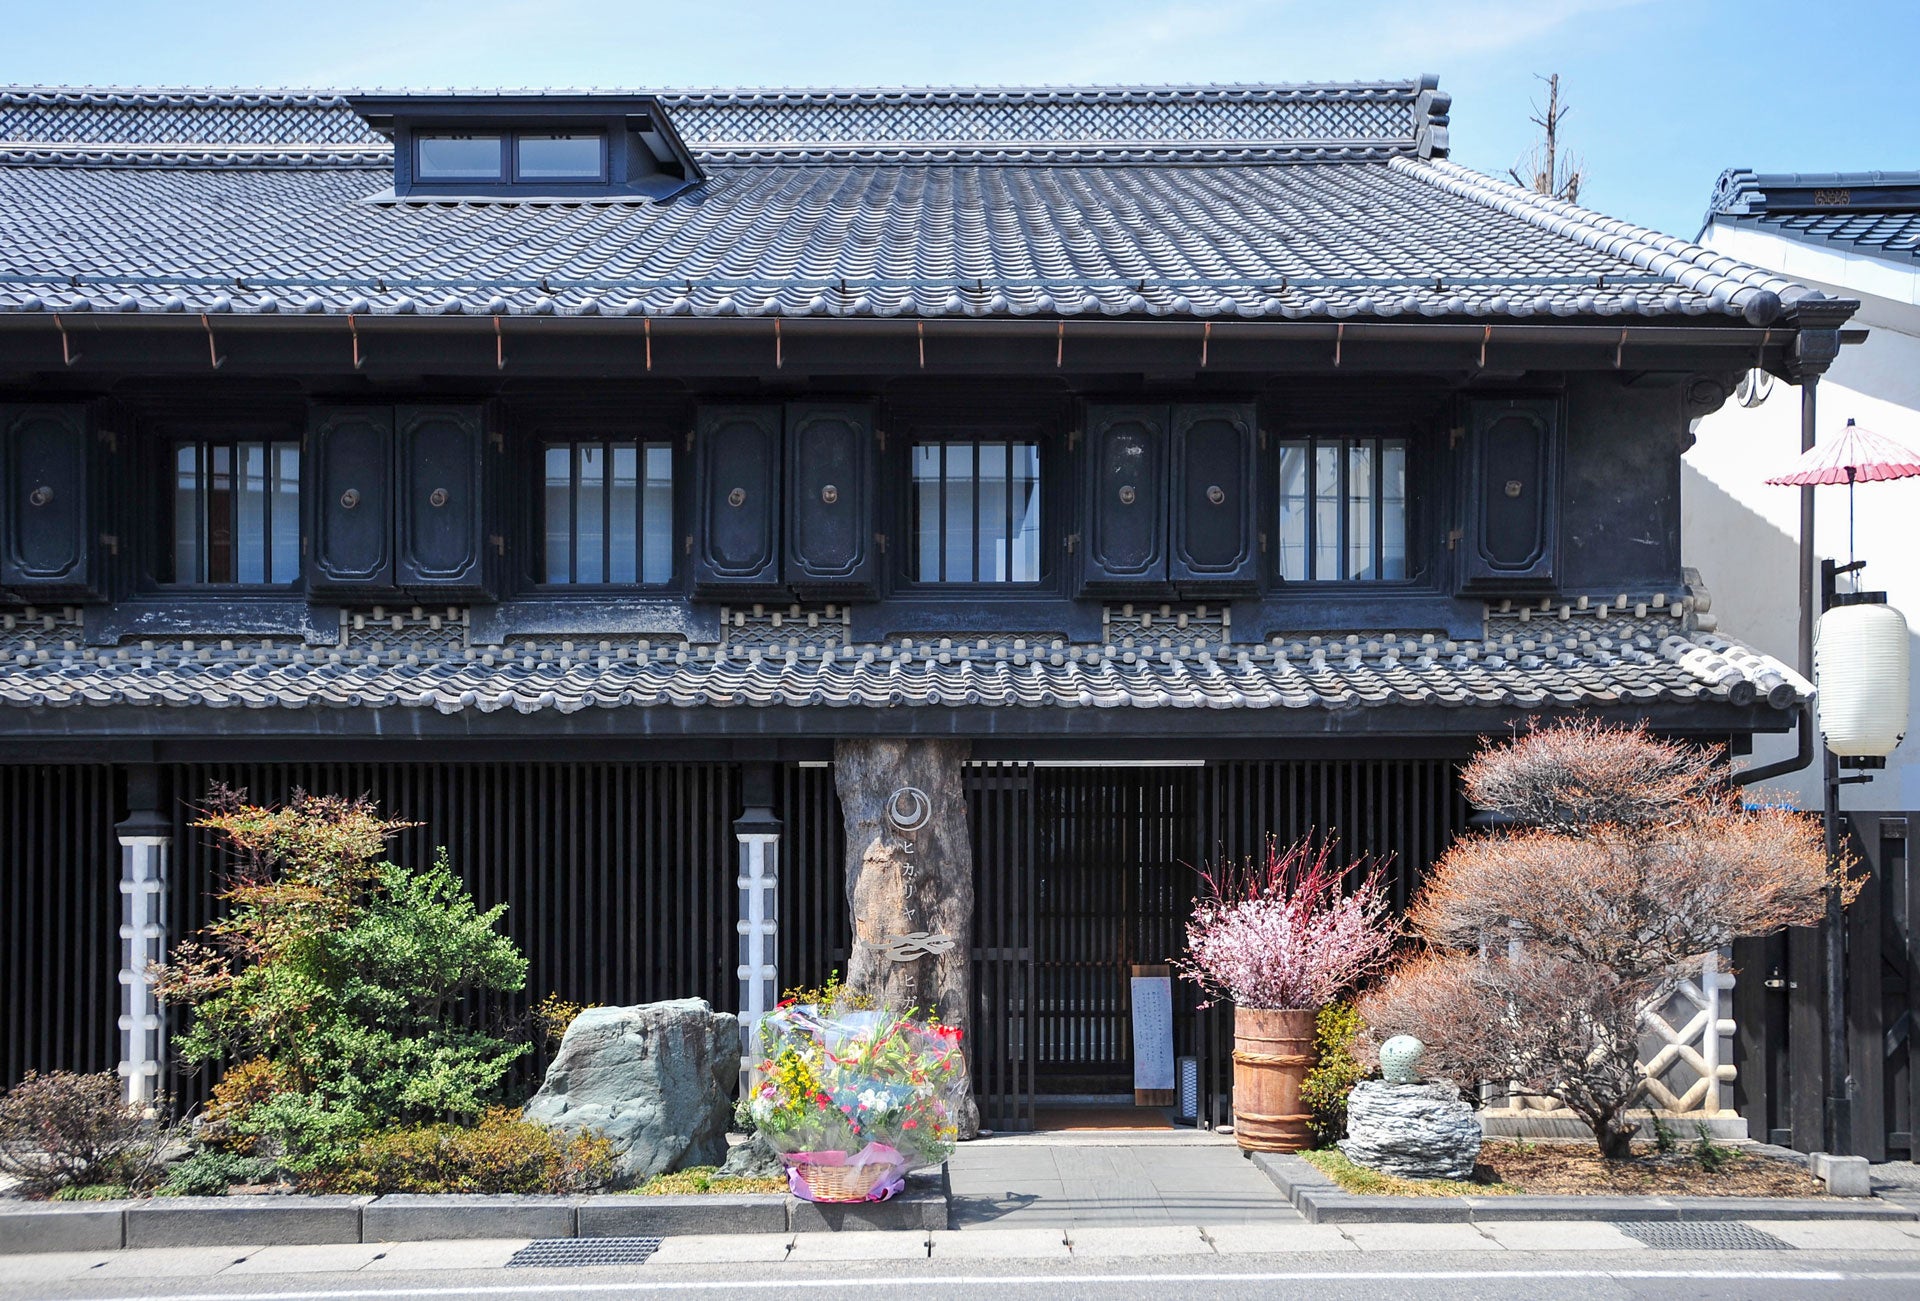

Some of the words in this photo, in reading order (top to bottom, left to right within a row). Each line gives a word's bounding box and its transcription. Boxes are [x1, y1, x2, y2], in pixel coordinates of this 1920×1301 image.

[902, 841, 915, 921] ヒカリヤ
[903, 974, 918, 1026] ヒガ
